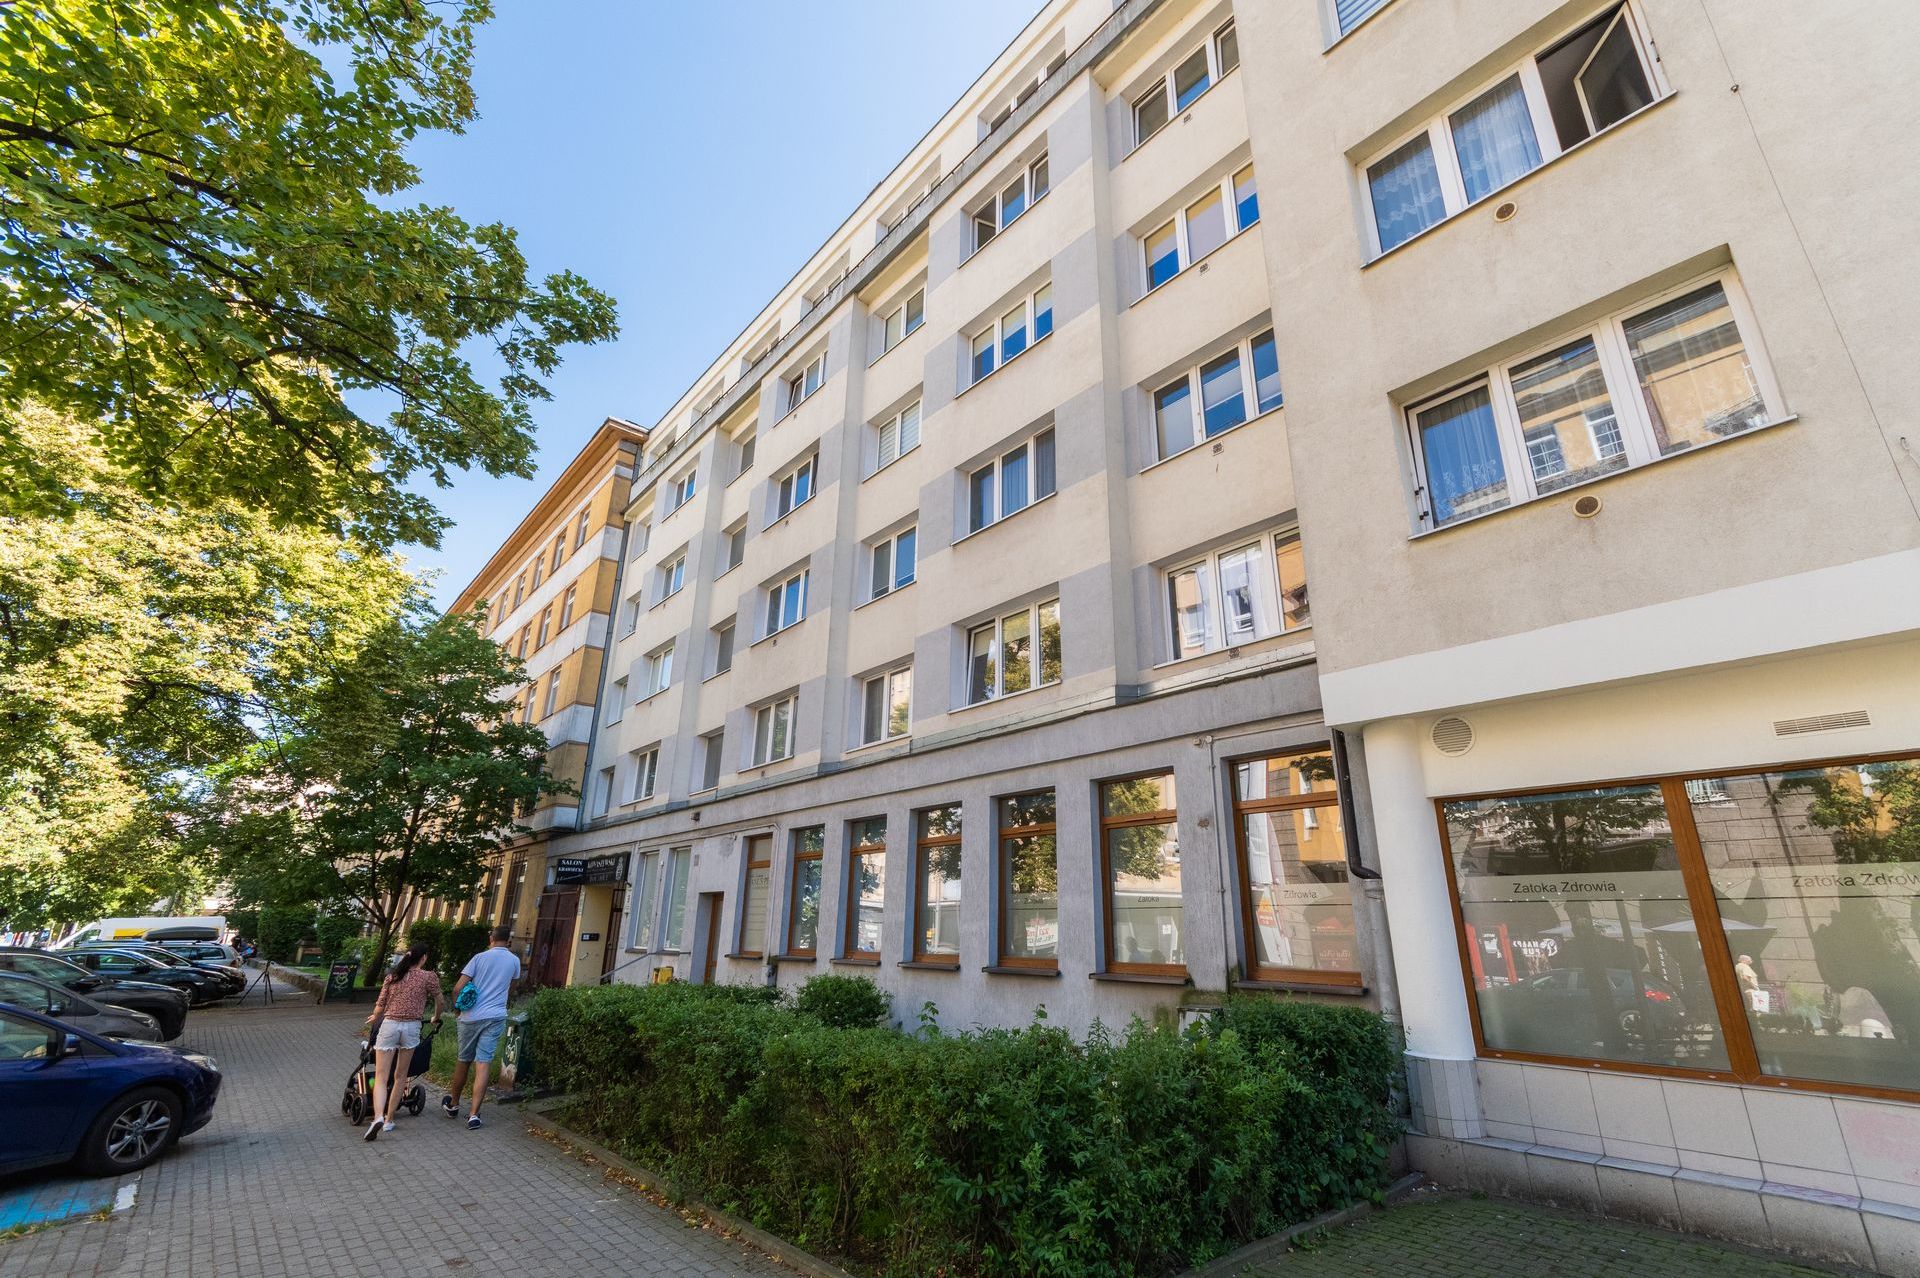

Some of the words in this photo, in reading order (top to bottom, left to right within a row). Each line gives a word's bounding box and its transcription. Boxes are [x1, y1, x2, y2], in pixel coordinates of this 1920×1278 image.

[1513, 882, 1557, 894] Zatoka
[1560, 880, 1617, 893] Zdrowia
[1792, 875, 1856, 888] Zatoka
[1283, 890, 1318, 899] Zdrowia
